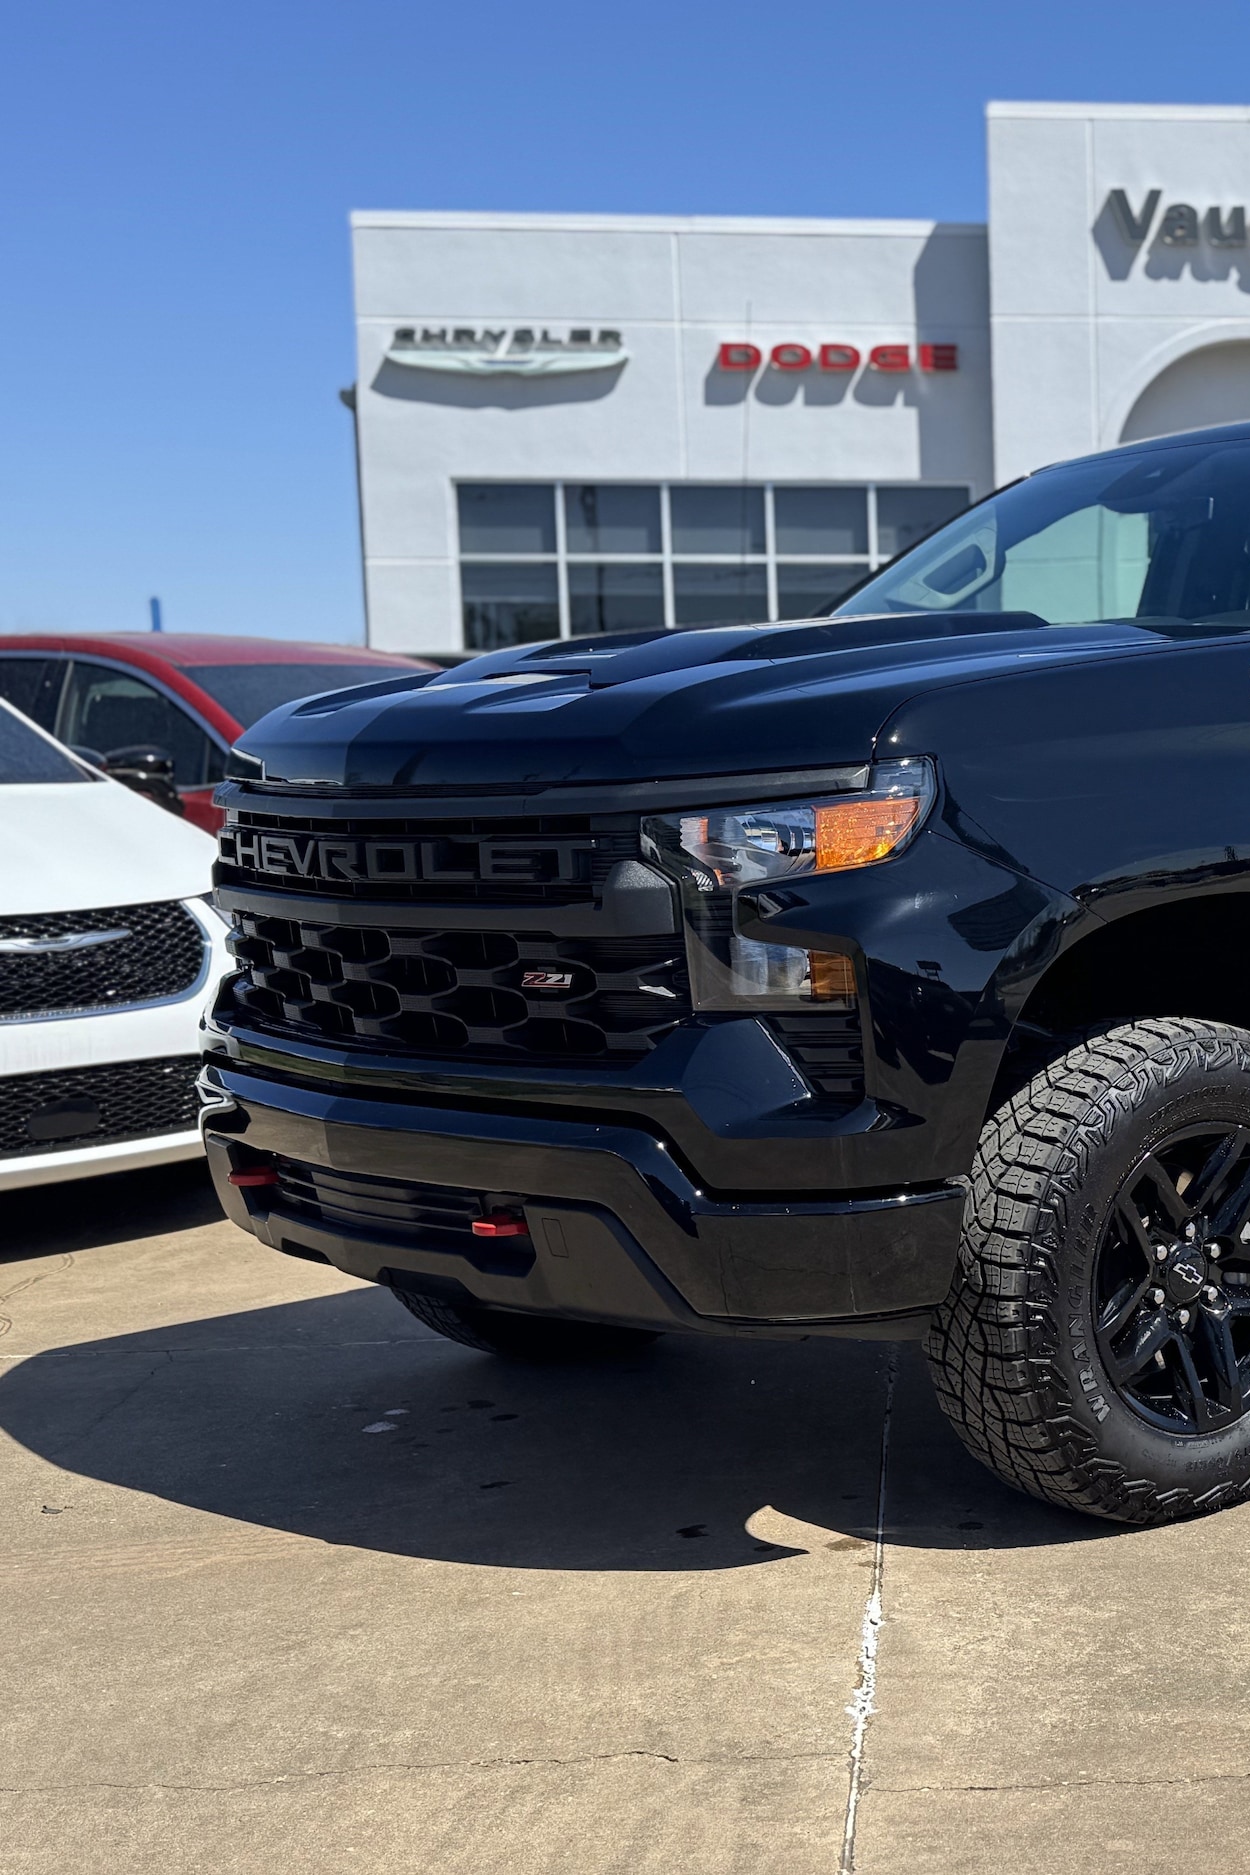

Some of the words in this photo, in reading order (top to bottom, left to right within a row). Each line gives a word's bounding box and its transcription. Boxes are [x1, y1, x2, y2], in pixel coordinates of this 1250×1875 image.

[393, 327, 622, 346] CHRYSLER
[719, 343, 958, 373] DODGE
[217, 828, 594, 882] CHEVROLET
[521, 971, 573, 989] Z71
[1067, 1202, 1112, 1424] WRANGLER
